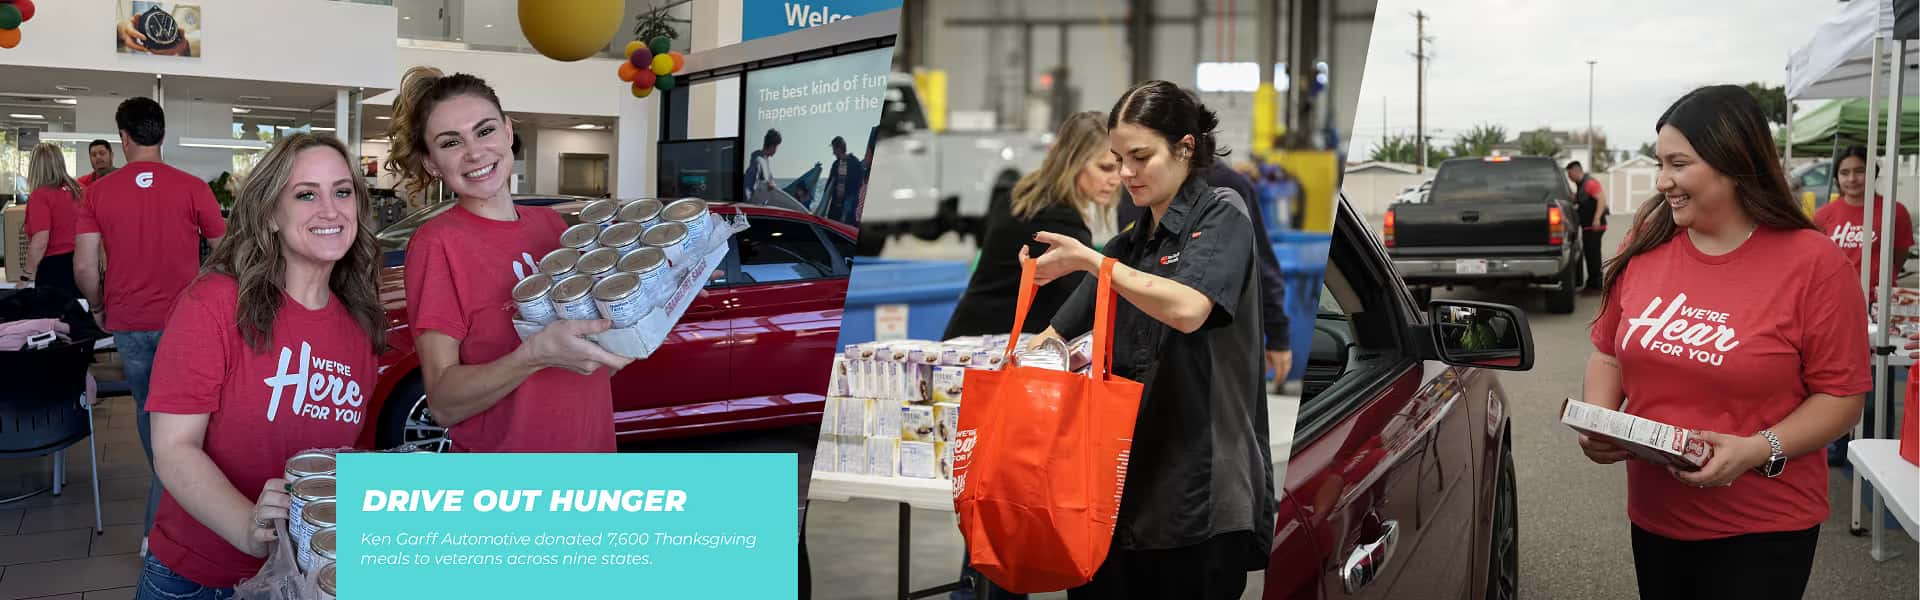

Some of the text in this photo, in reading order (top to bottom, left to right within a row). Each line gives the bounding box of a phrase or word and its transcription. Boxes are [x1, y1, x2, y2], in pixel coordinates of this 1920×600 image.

[759, 73, 887, 102] The best kind of fun
[758, 94, 879, 121] happens out of the
[1621, 292, 1740, 352] Hear
[1680, 305, 1730, 324] WE'RE
[1649, 340, 1724, 366] FOR YOU
[311, 356, 352, 377] WE'RE
[263, 340, 363, 422] Here
[301, 403, 361, 424] FOR YOU
